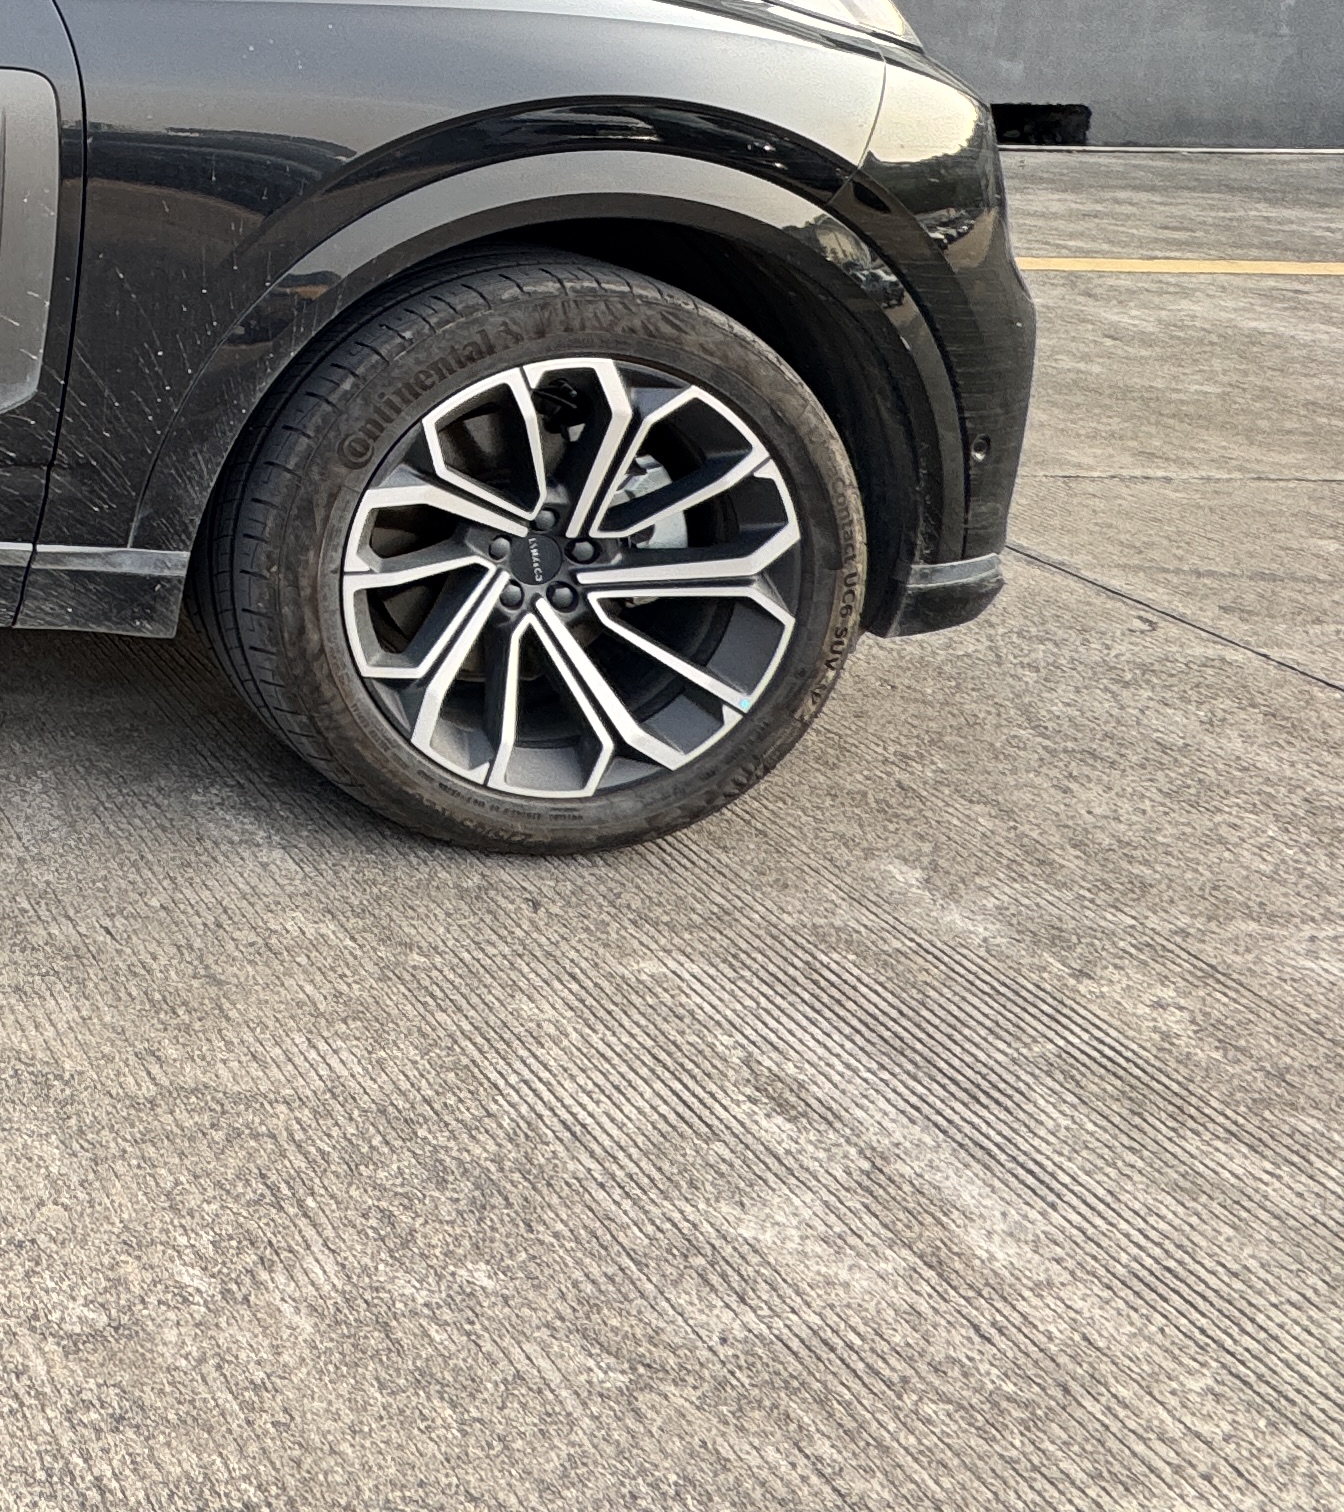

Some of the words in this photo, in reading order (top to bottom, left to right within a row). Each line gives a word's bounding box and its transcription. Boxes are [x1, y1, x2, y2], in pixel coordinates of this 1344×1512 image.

[337, 330, 498, 470] Continental
[831, 476, 857, 562] Contact
[839, 571, 858, 618] UC6
[825, 627, 848, 671] SUV
